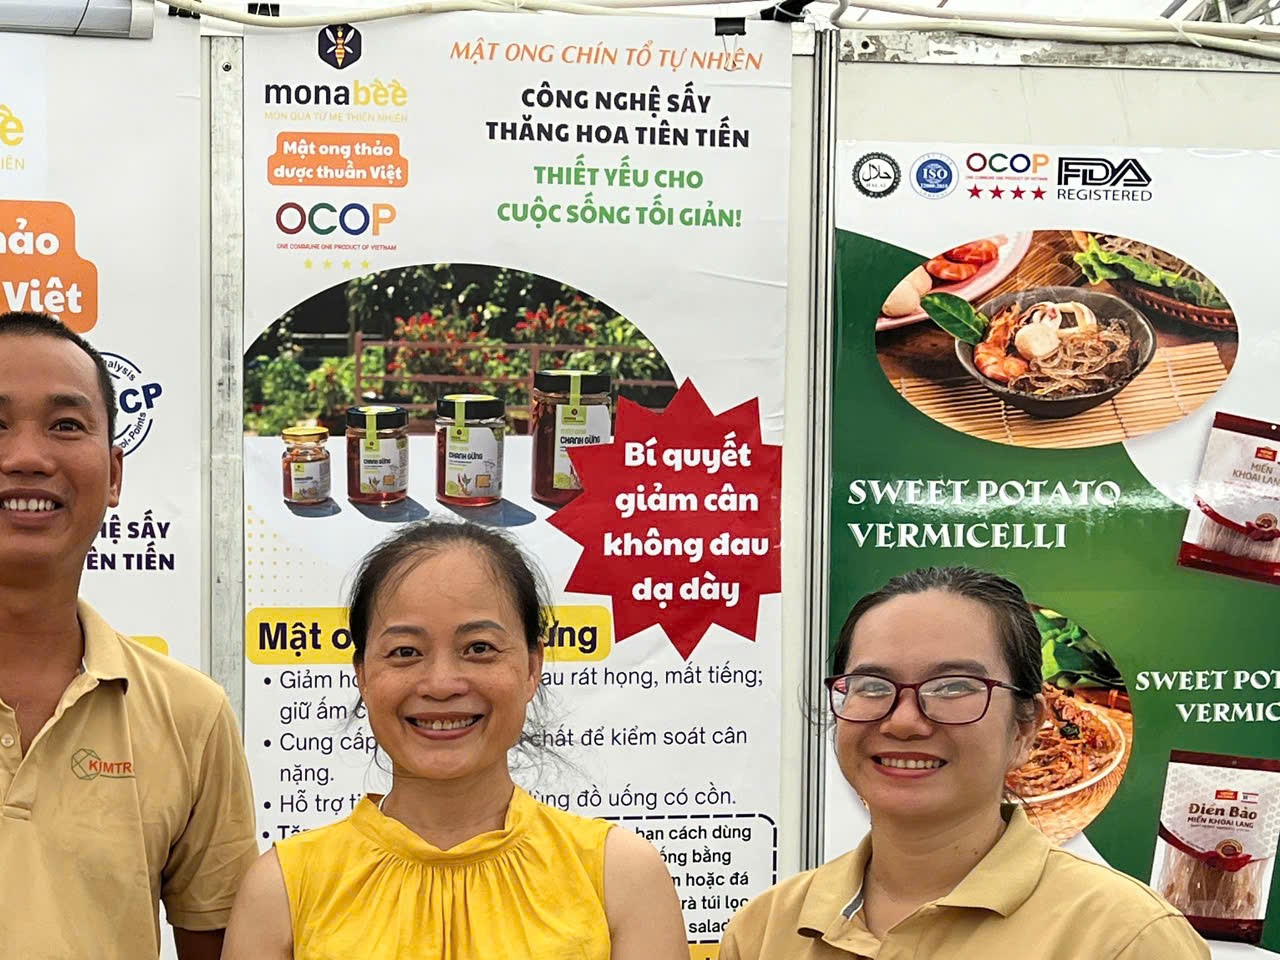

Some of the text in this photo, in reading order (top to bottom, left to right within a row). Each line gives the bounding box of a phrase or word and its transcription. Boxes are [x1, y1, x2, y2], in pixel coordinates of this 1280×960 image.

[922, 167, 949, 180] ISO
[966, 152, 1050, 173] OCOP
[1058, 157, 1152, 187] FDA
[1058, 188, 1152, 201] REGISTERED
[275, 202, 397, 236] OCOP
[3, 278, 82, 320] Việt
[624, 432, 752, 475] Bí quyết
[615, 486, 759, 518] giảm cân
[847, 479, 1122, 506] SWEET POTATO
[603, 532, 769, 563] không đau
[847, 523, 1068, 549] VERMICELLI
[632, 572, 740, 609] dạ dày
[1136, 670, 1228, 691] SWEET
[608, 782, 736, 810] uống có cồn.
